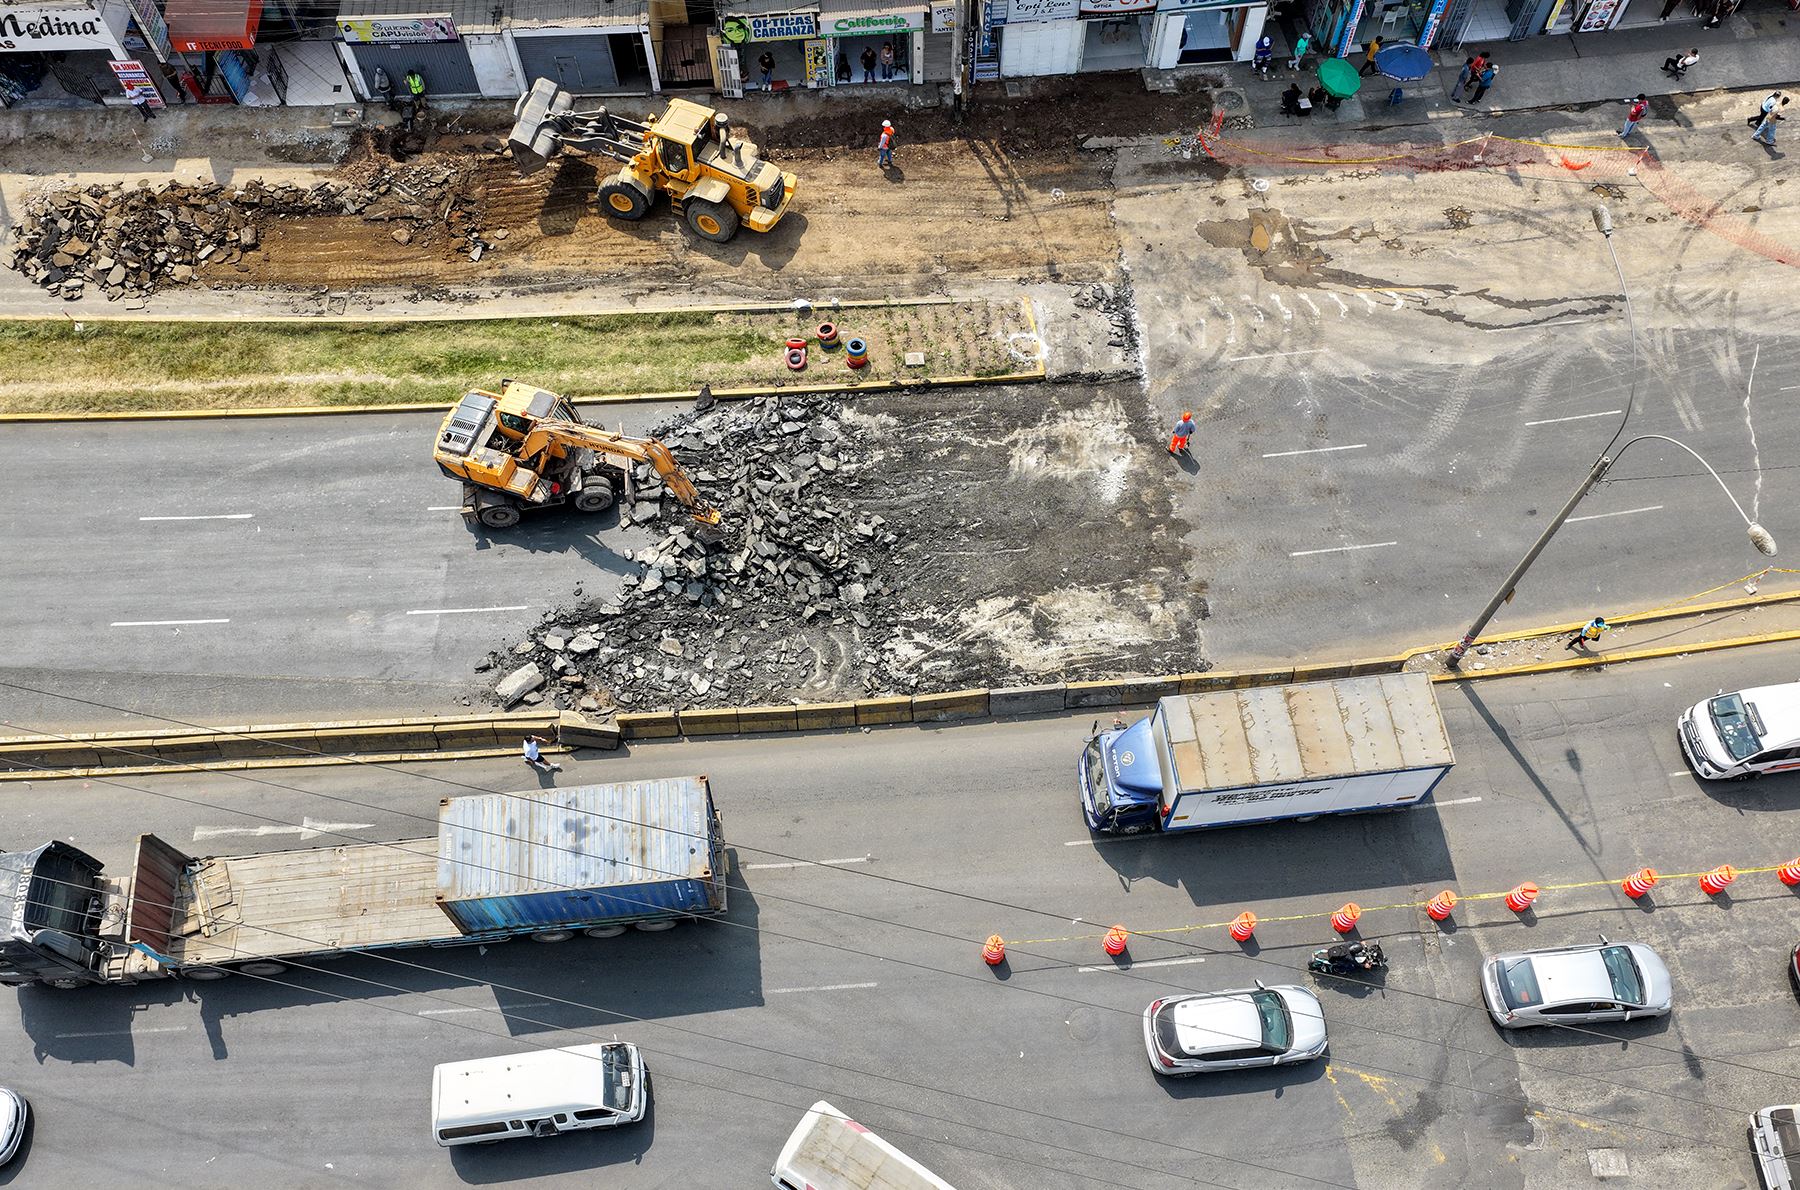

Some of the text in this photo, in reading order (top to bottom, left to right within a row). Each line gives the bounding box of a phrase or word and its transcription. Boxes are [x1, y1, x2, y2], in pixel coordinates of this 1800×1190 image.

[834, 15, 907, 31] California
[753, 25, 815, 38] CARRANZA
[806, 47, 814, 81] OPTICA
[589, 443, 625, 455] HYUNDAI
